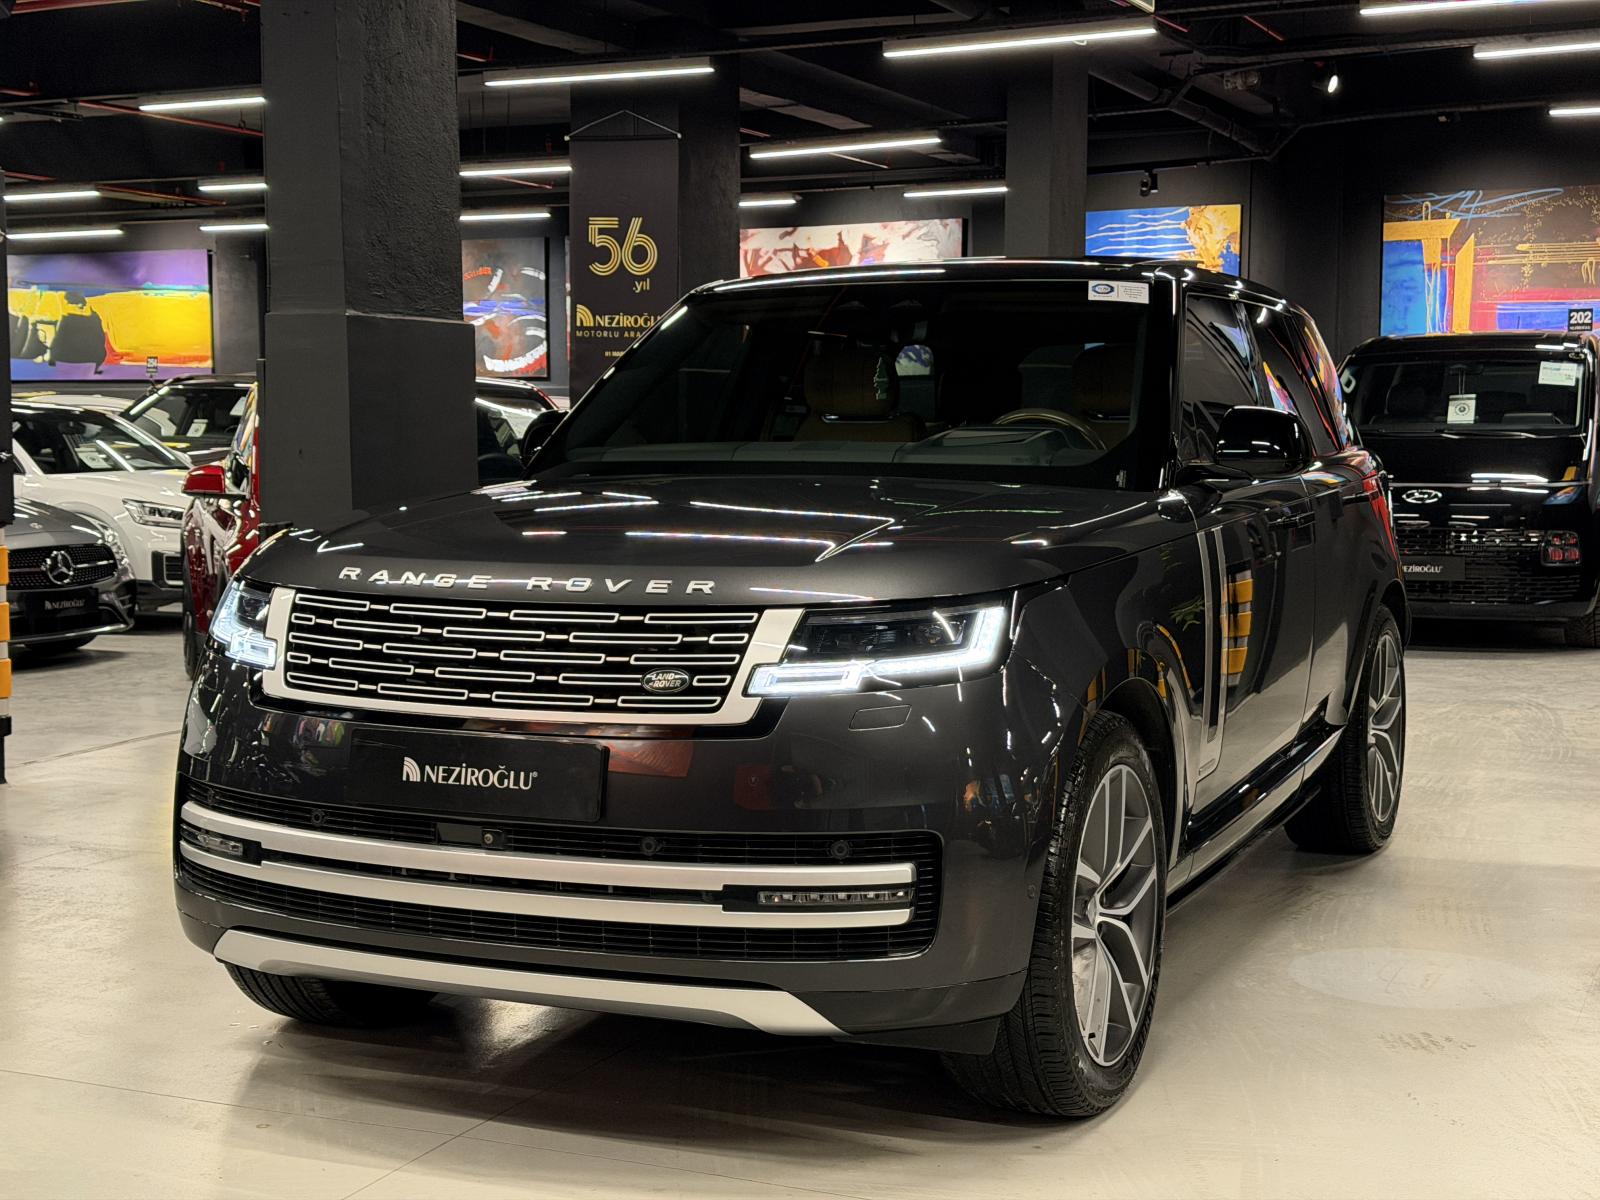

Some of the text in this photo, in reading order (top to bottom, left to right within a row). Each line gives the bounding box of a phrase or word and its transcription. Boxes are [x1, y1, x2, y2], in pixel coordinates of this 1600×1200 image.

[588, 217, 658, 276] 56
[1569, 311, 1592, 324] 202
[576, 330, 619, 338] MOTORLU
[337, 566, 717, 595] RANGE ROVER
[651, 672, 675, 681] LAND
[652, 680, 682, 688] ROVER
